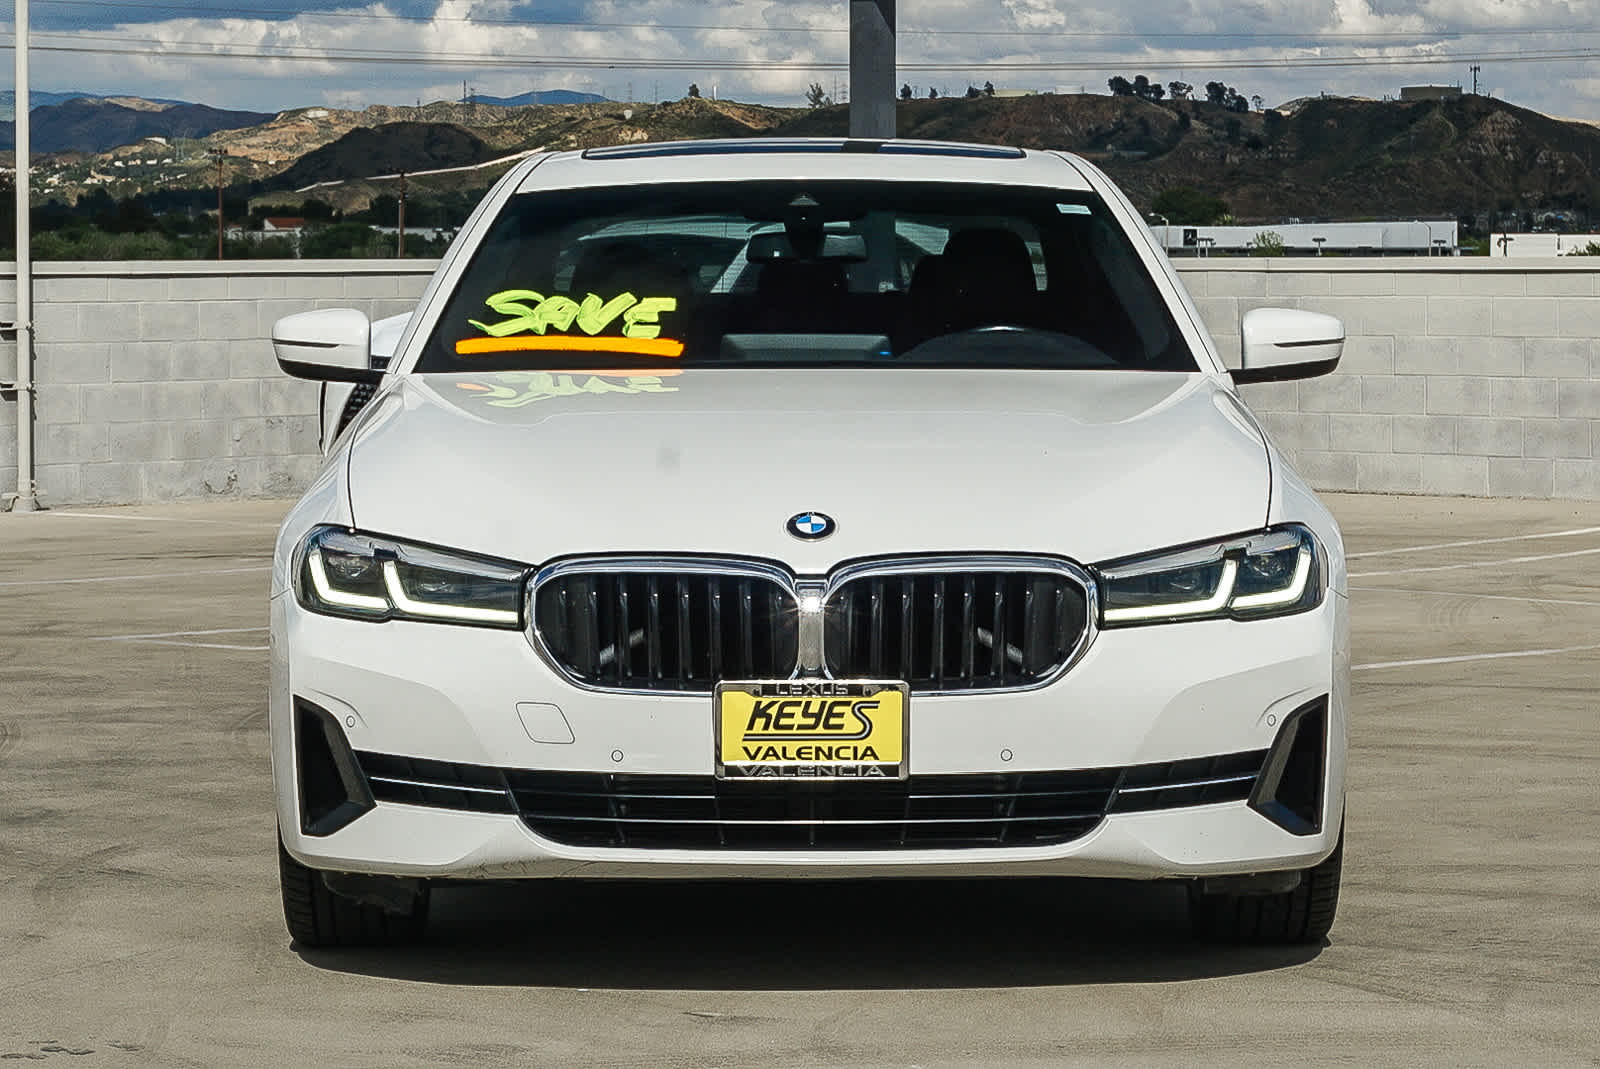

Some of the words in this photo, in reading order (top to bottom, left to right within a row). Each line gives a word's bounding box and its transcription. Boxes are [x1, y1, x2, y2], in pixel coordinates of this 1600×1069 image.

[468, 289, 677, 339] SAVE
[776, 684, 848, 695] LEXUS
[743, 700, 880, 741] KEYES
[742, 746, 880, 760] VALENCIA
[737, 764, 886, 777] VALENCIA
